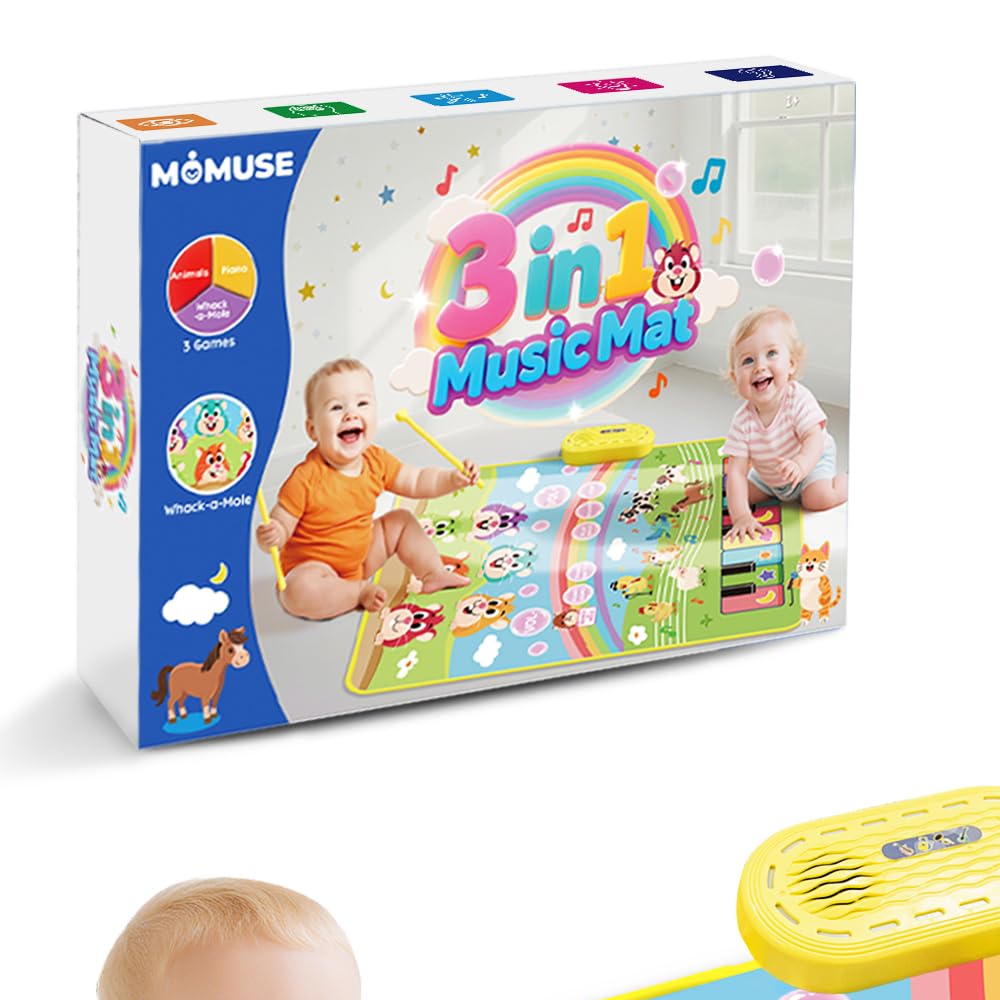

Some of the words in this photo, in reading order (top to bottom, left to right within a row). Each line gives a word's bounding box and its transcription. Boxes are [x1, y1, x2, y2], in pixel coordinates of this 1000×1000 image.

[170, 268, 209, 281] Animals
[221, 264, 248, 275] Piano
[436, 211, 518, 341] 3
[524, 224, 602, 320] in
[604, 200, 653, 304] 1
[183, 340, 191, 353] 3
[193, 337, 236, 352] Games
[431, 320, 592, 410] Music
[596, 298, 695, 364] Mat
[163, 494, 252, 515] Whack-a-Mole
